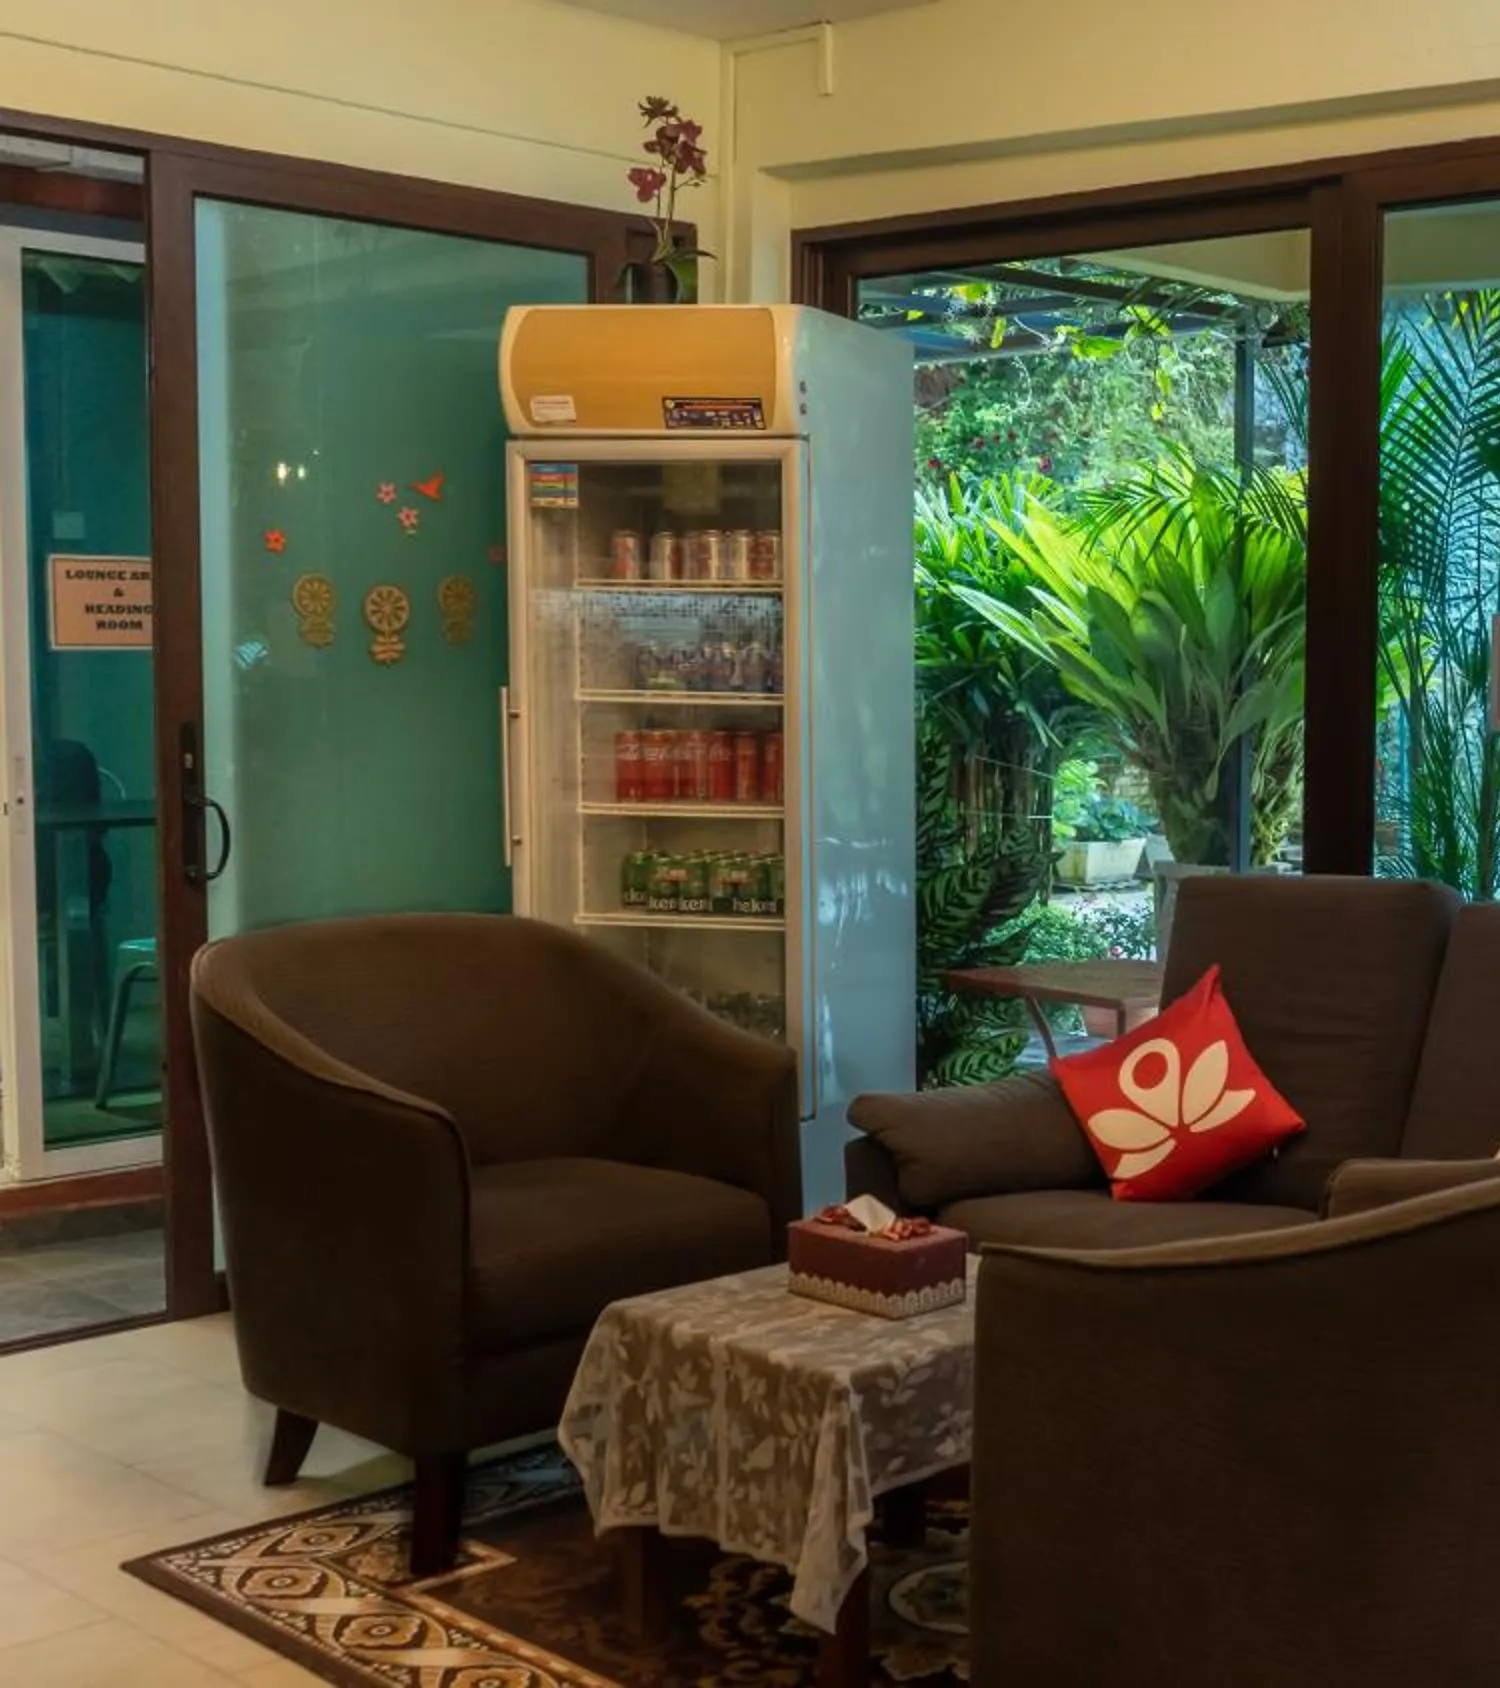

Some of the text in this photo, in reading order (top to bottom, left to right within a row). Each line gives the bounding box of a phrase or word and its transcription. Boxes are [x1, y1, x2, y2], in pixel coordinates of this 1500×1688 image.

[65, 570, 151, 581] LOUNGE AR
[113, 587, 124, 597] &
[84, 603, 153, 614] READING
[96, 620, 143, 630] ROOM
